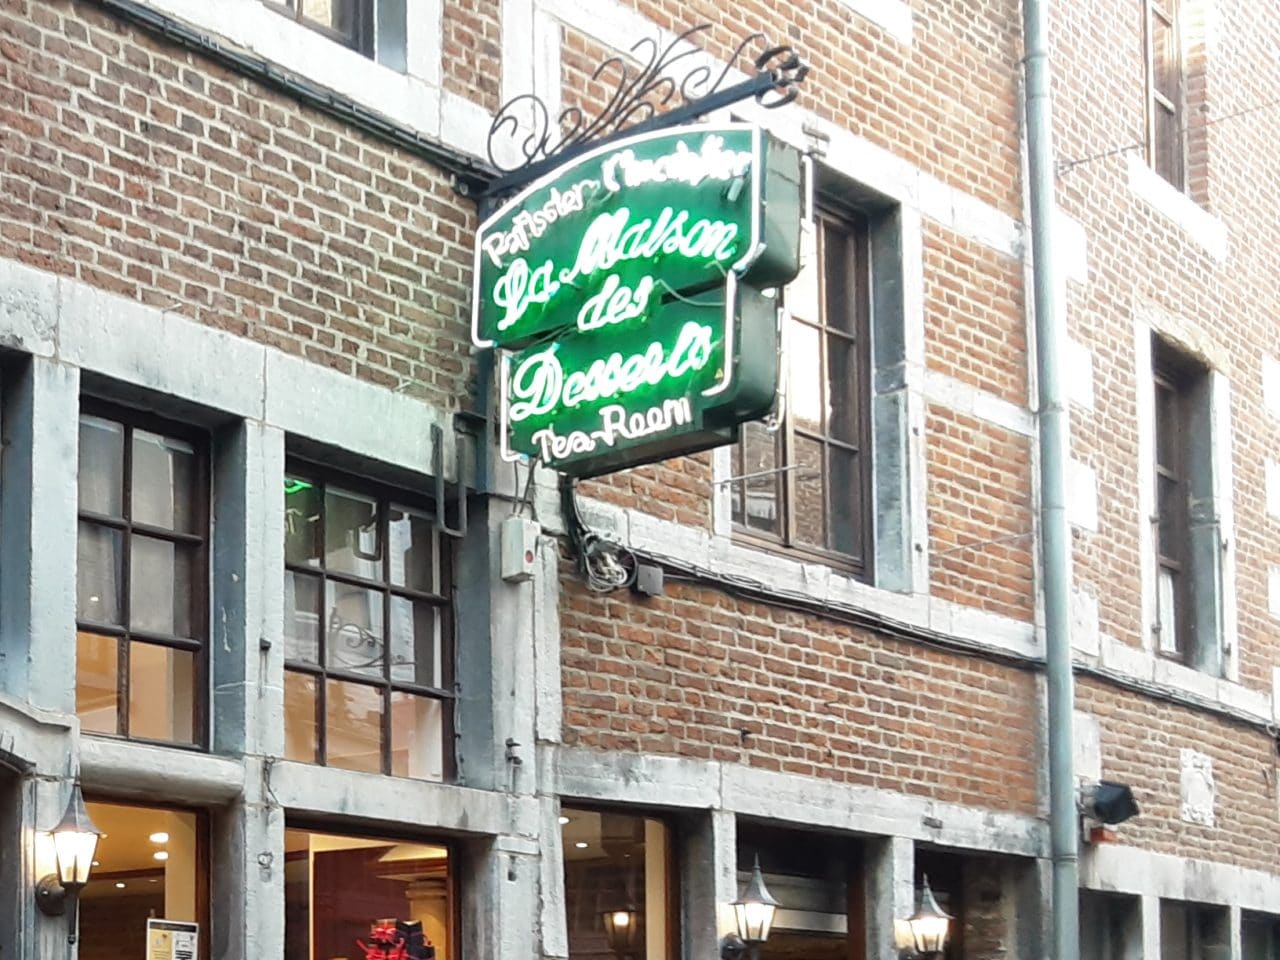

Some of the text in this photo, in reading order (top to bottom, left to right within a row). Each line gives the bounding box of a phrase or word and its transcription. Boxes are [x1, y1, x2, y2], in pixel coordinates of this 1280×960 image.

[493, 206, 737, 330] La Maison
[577, 272, 654, 332] des
[509, 320, 713, 422] Desserts
